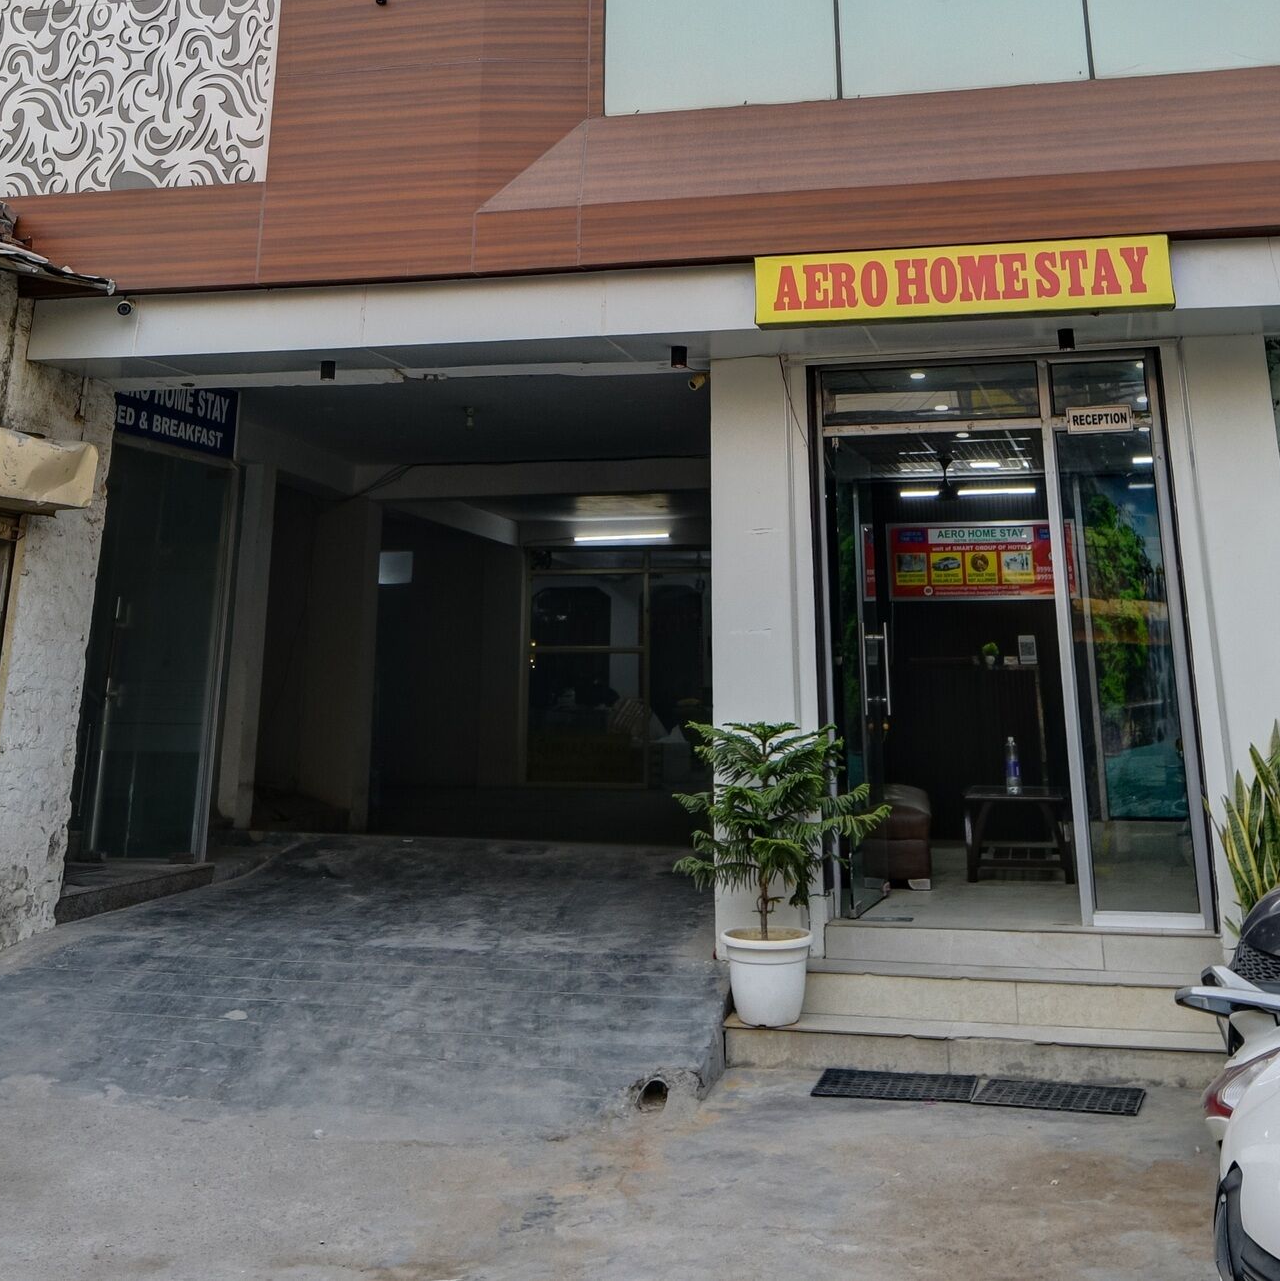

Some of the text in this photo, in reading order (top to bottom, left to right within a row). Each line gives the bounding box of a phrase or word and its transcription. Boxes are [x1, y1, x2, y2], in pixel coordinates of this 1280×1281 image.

[773, 247, 1149, 311] AERO HOME STAY
[197, 390, 230, 423] STAY
[1072, 412, 1127, 426] RECEPTION
[116, 404, 223, 449] ED & BREAKFAST
[937, 528, 1024, 539] AERO HOME STAY
